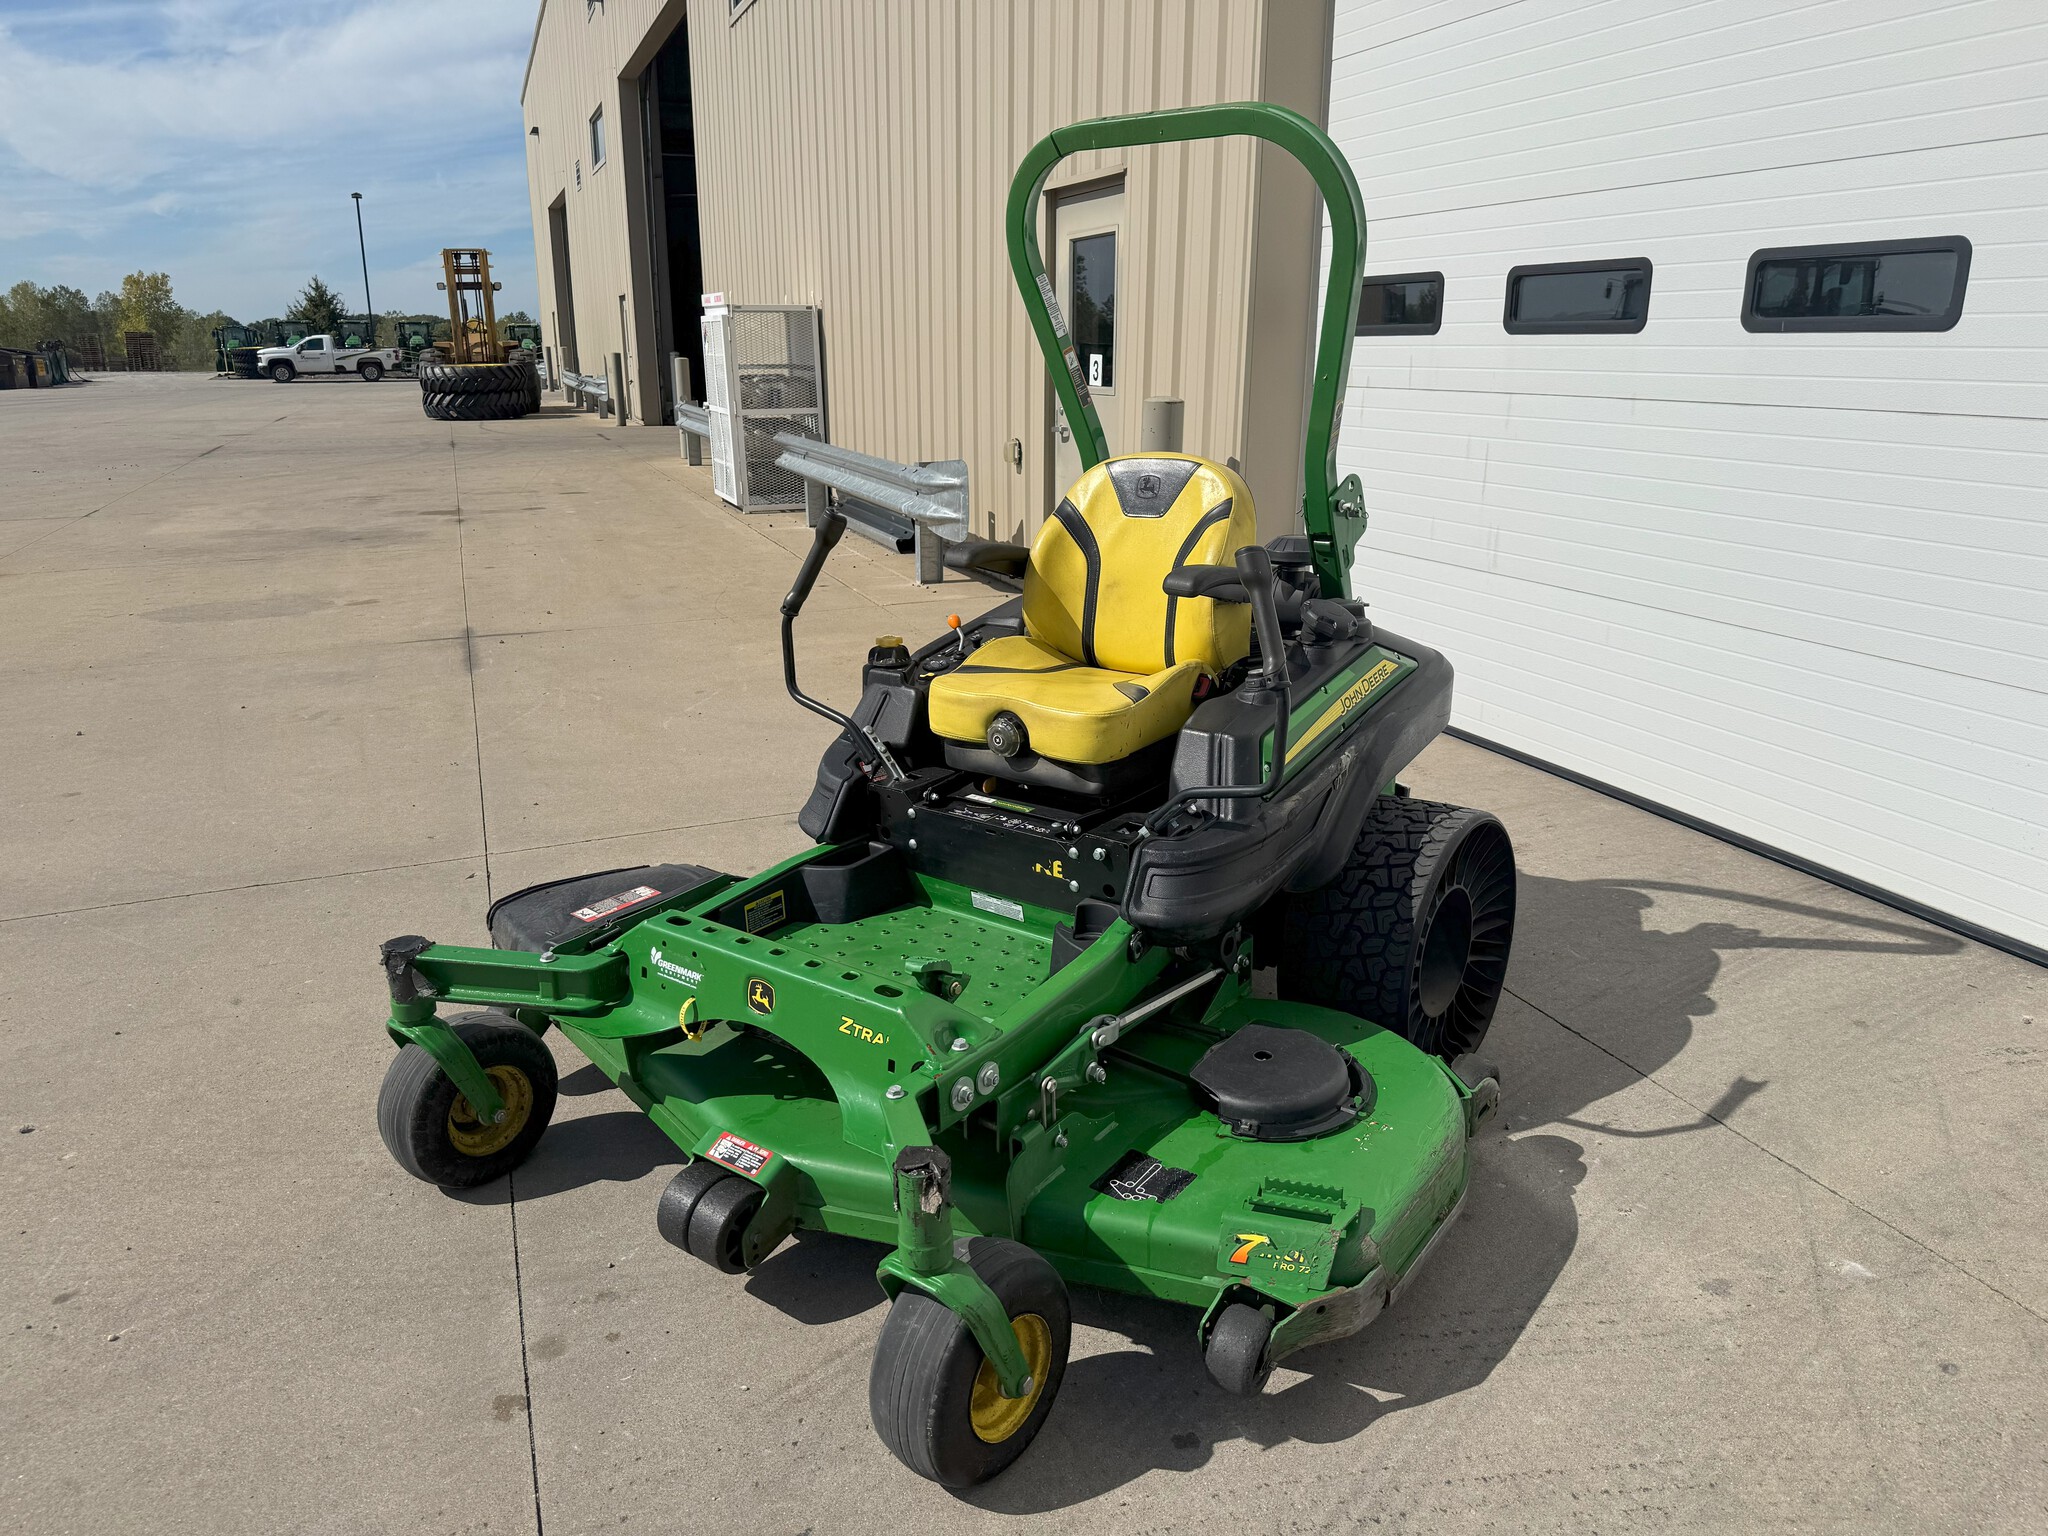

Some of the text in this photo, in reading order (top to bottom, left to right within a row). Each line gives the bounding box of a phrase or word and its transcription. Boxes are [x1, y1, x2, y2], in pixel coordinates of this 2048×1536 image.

[1092, 360, 1099, 382] 3
[1340, 664, 1390, 716] JOHN DEERE
[657, 958, 702, 982] GREENMARK
[839, 1015, 890, 1044] ZTRA
